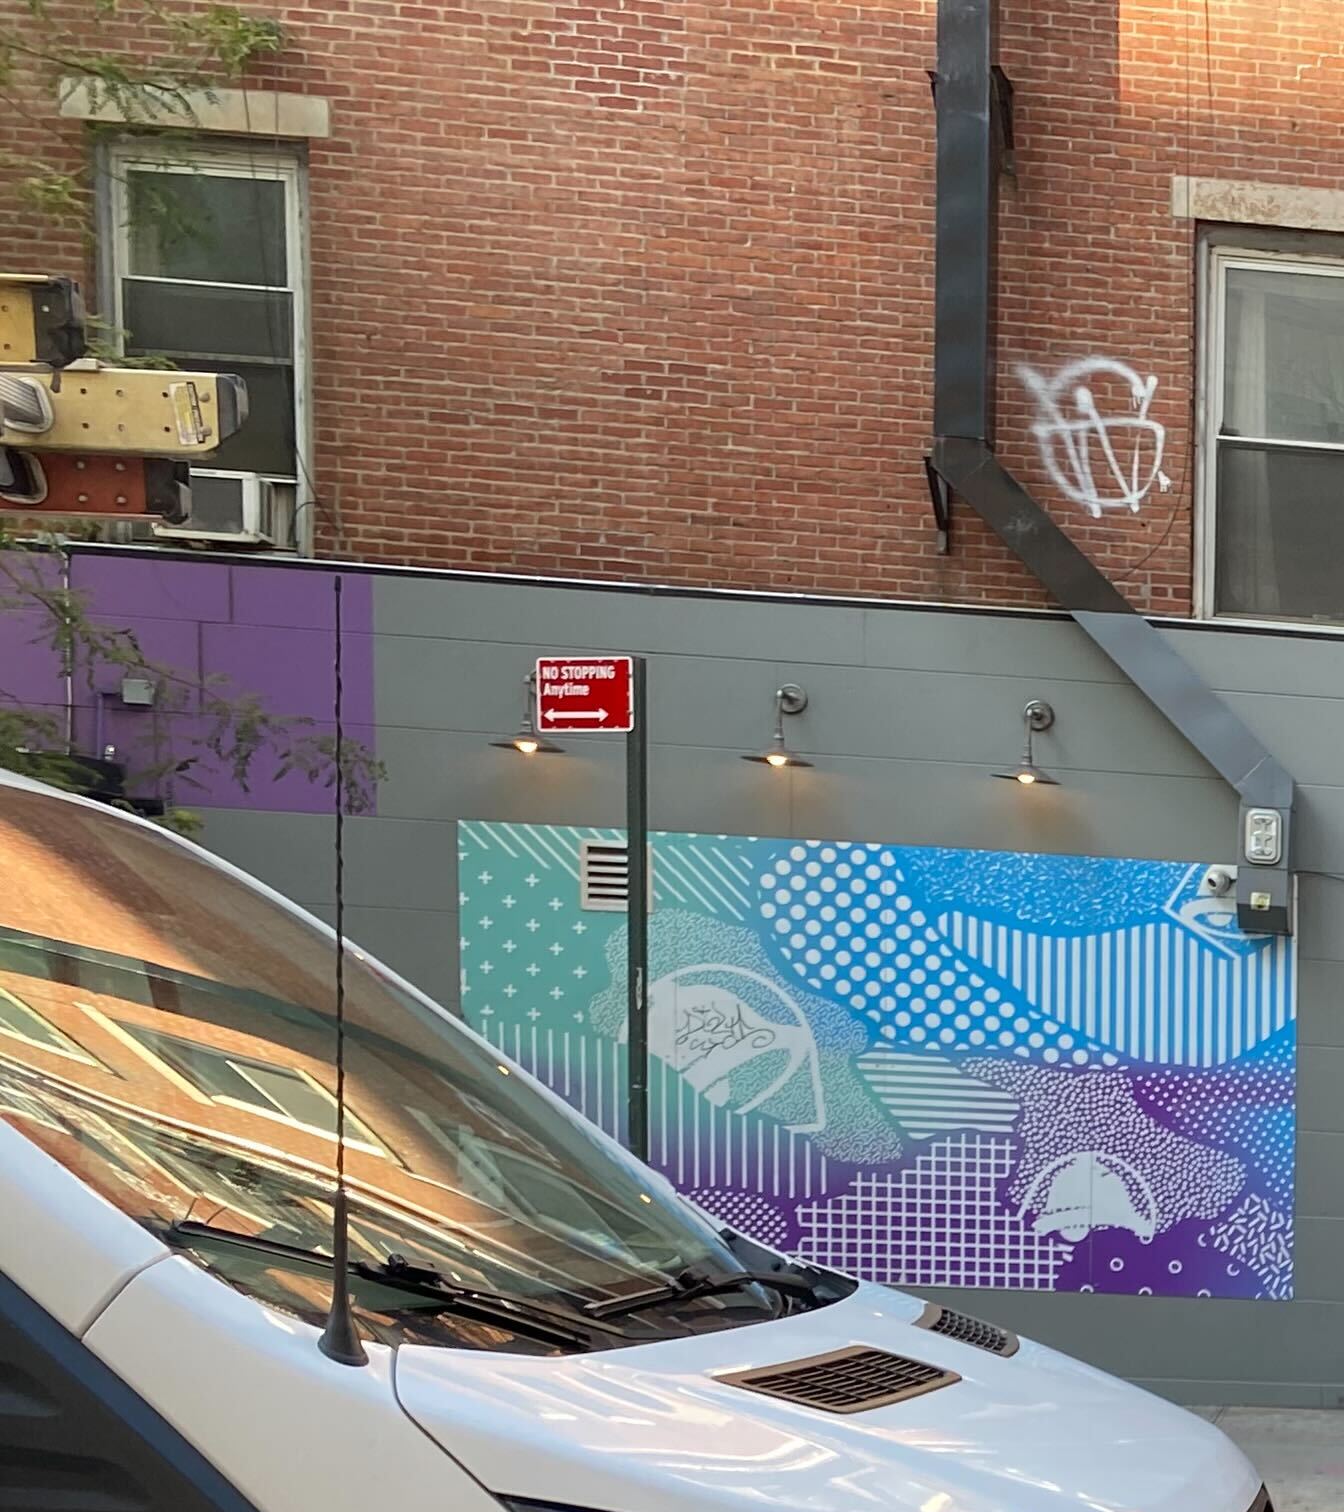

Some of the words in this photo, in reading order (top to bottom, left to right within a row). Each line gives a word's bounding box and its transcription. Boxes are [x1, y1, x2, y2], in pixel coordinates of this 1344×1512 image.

[542, 666, 559, 680] NO
[561, 666, 615, 679] STOPPING
[543, 682, 590, 699] Anytime
